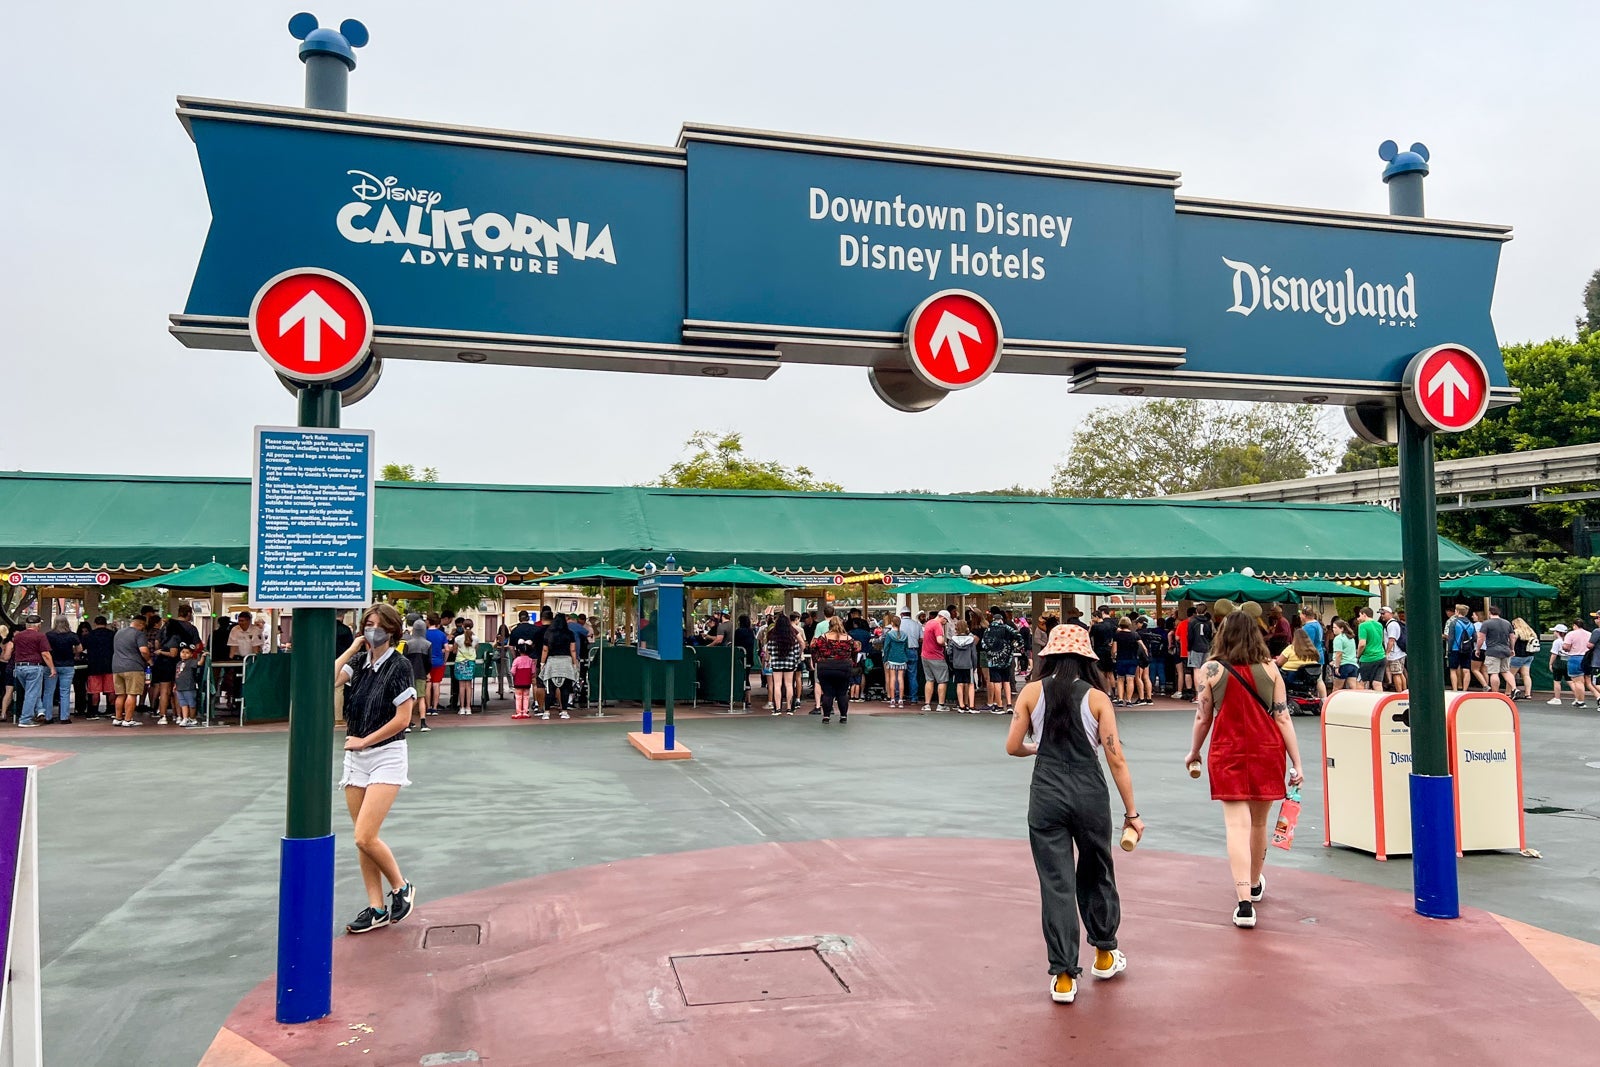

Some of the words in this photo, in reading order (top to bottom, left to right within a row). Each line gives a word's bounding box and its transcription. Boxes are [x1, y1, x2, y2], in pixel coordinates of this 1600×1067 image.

[347, 170, 441, 213] Disney
[336, 202, 617, 264] CALIFORNIA
[809, 187, 966, 232] Downtown
[976, 202, 1072, 247] Disney
[400, 249, 558, 274] ADVENTURE
[840, 235, 942, 280] Disney
[951, 243, 1045, 280] Hotels
[1222, 256, 1418, 325] Disneyland
[1379, 318, 1416, 327] Park
[1389, 751, 1413, 765] Disne
[1464, 749, 1506, 763] Disneyland
